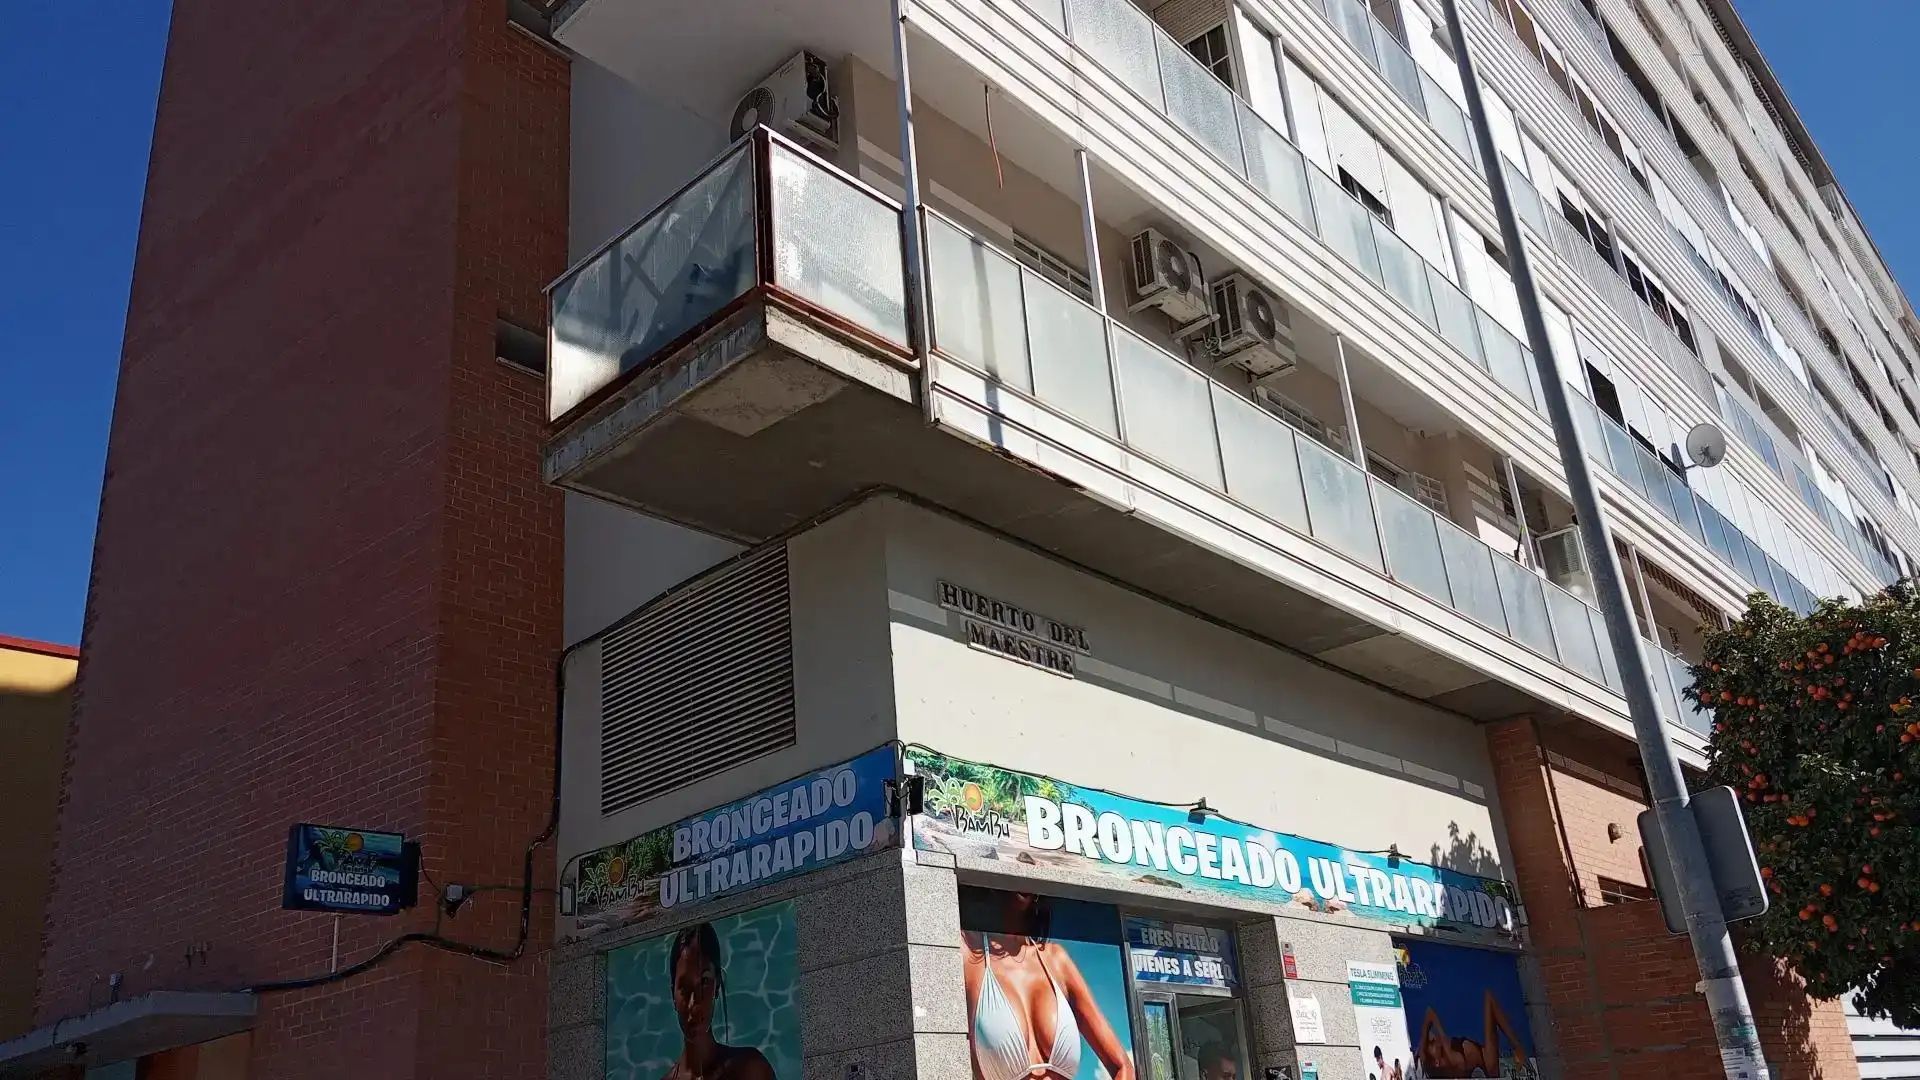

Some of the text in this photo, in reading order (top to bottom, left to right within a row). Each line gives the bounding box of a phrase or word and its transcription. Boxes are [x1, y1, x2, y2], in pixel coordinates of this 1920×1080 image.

[941, 582, 1090, 650] HUERTO DEL
[970, 623, 1074, 673] MAESTRE
[672, 768, 857, 863] BRONCEADO
[311, 869, 386, 888] BRONCEADO
[659, 811, 874, 909] ULTRARAPIDO
[1024, 795, 1513, 931] BRONCEADO ULTRARAPIDO
[303, 888, 390, 907] ULTRARAPIDO
[1141, 927, 1174, 948] ERES
[1176, 932, 1209, 952] FELIZ
[1133, 954, 1181, 976] VIENES
[1183, 960, 1193, 977] A
[1350, 968, 1367, 978] TESLA
[1367, 969, 1395, 981] SLIMMING
